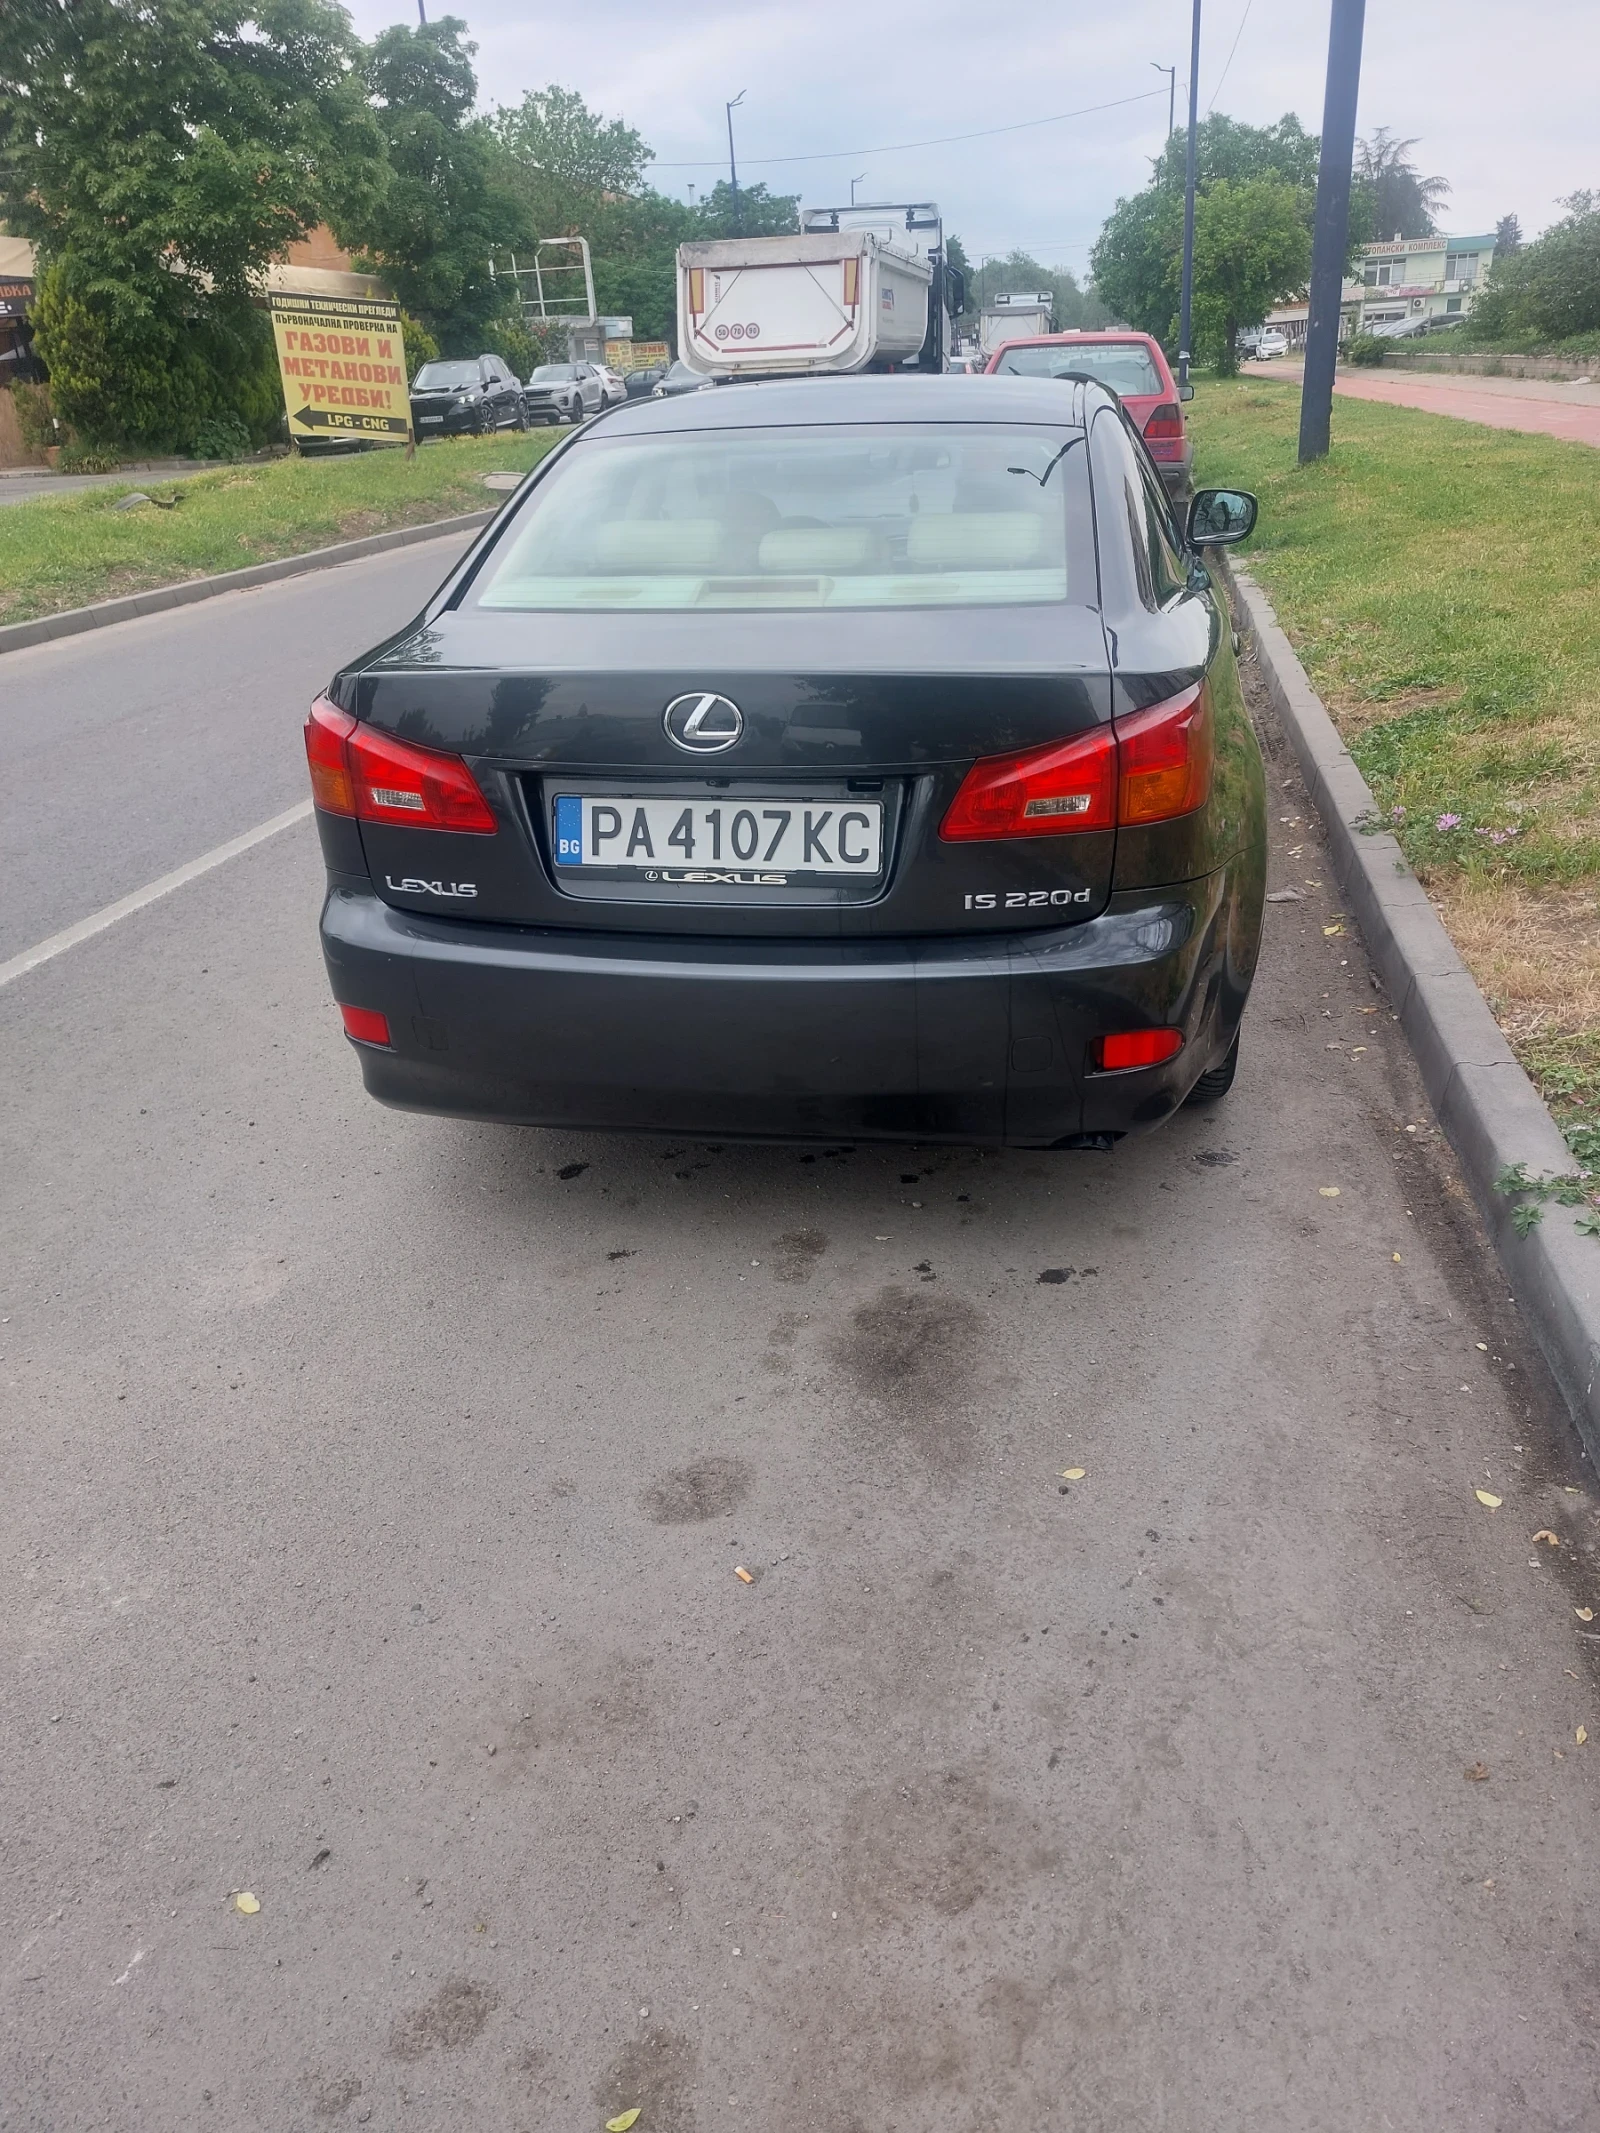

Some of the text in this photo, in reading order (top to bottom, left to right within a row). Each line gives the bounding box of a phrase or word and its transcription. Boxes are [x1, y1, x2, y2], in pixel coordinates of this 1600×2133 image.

[1408, 241, 1447, 251] КОМПЛЕКС
[272, 297, 397, 318] ГОДИШНИ ТЕХНИЧЕСКИ ПРЕГЛЕДИ
[275, 313, 398, 334] ПЪРВОНАЧАЛНА ПРОВЕРКА НА
[284, 331, 393, 359] ГАЗОВИ И
[283, 356, 403, 385] МЕТАНОВИ
[298, 382, 392, 409] УРЕДБИ!
[327, 413, 353, 427] LPG
[362, 416, 390, 431] CNG
[591, 805, 870, 864] PA 4107 KC
[559, 839, 580, 854] BG
[384, 875, 478, 897] LEXUS
[662, 871, 788, 885] LEXUS
[964, 888, 1091, 910] IS 220d
